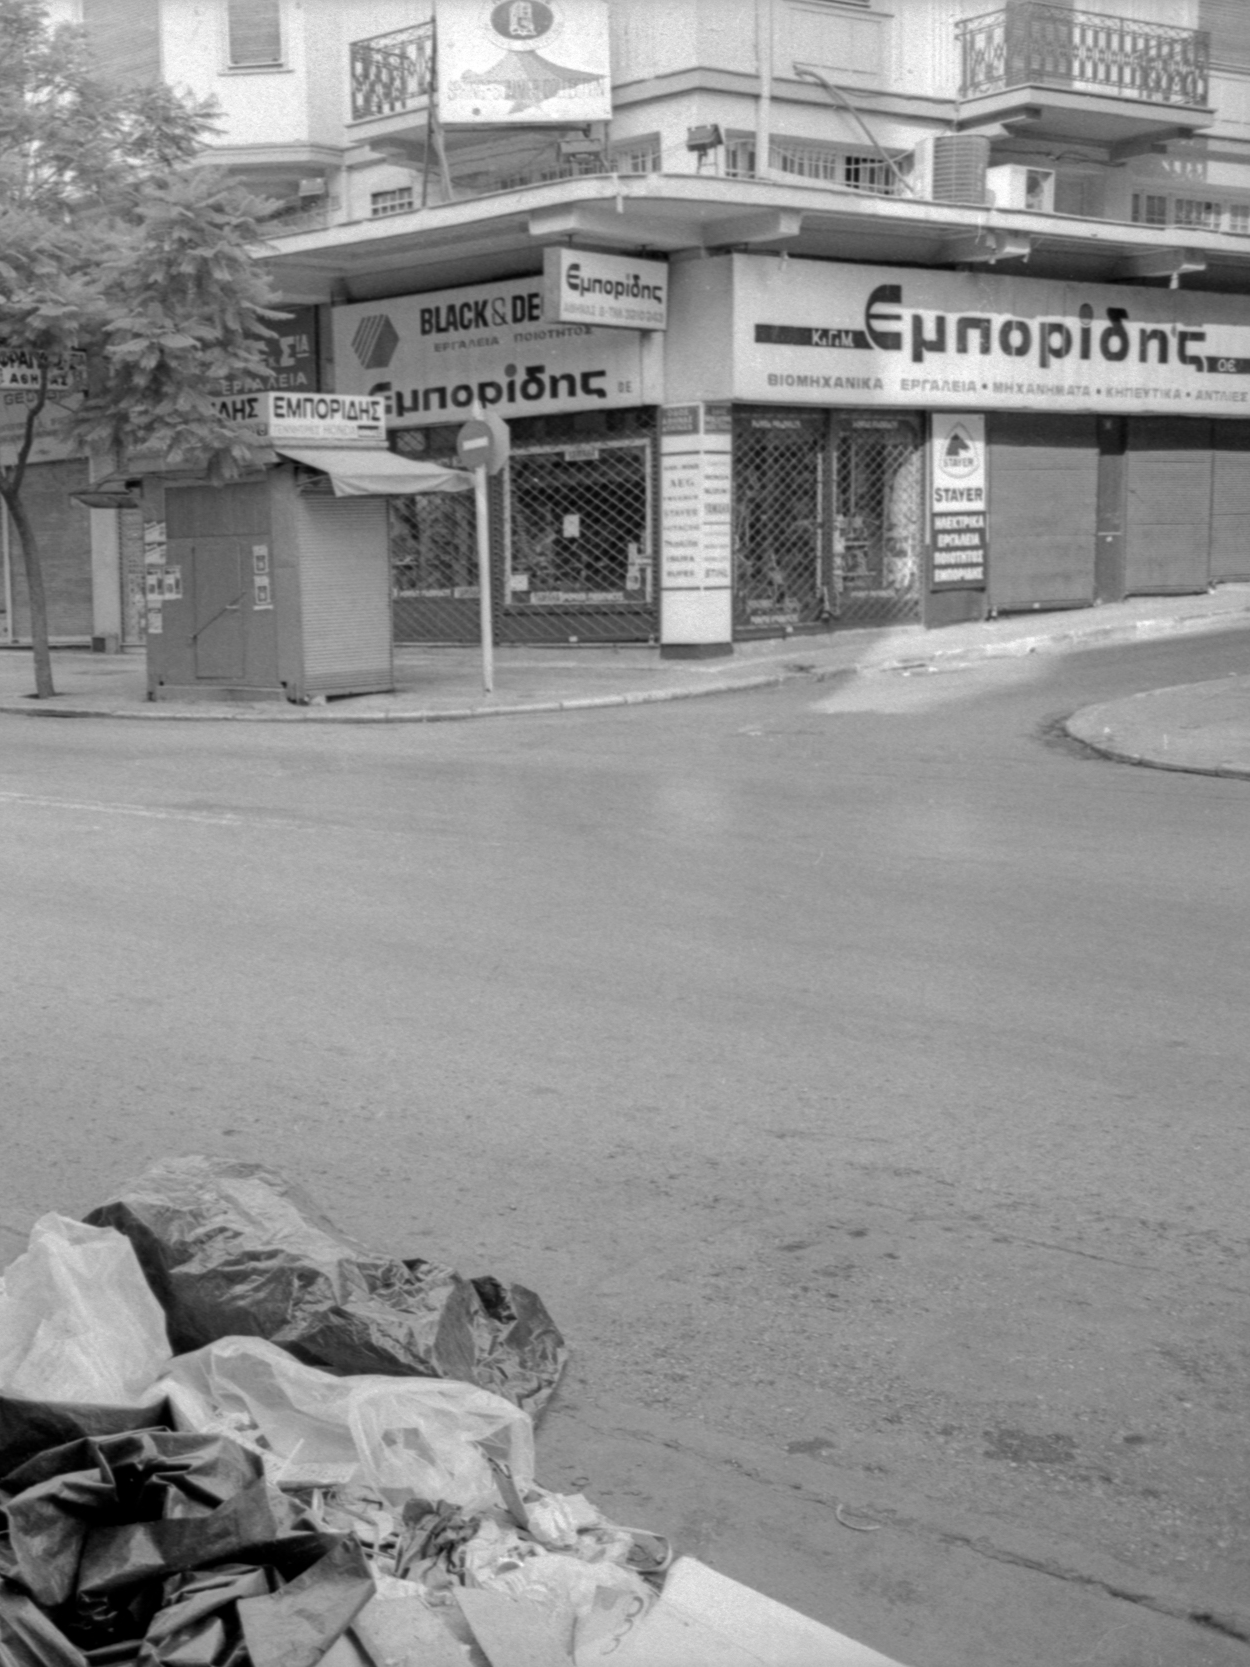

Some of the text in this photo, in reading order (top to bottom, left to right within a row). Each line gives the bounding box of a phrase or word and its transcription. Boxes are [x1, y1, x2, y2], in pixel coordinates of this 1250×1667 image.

[566, 263, 662, 304] Εμπορίδης
[865, 284, 1206, 373] Εμπορίδης
[434, 325, 592, 352] ΕΡΓΑΛΕΙΑ ΠΟΙΟΤΗΤΟΣ
[9, 373, 68, 387] ΑΘΗΑΣ
[767, 373, 884, 390] ΒΙΟΜΗΧΑΝΙΚΑ
[900, 378, 978, 393] ΕΡΓΑΛΕΙΑ
[993, 382, 1091, 397] ΜΗΧΑΝΗΜΑΤΑ
[1106, 386, 1181, 400] ΚΗΠΕΥΤΙΚΑ
[274, 396, 381, 421] ΕΜΠΟΡΙΔΗΣ
[943, 458, 974, 468] STAYER
[934, 487, 983, 502] STAYER
[934, 514, 985, 530] ΗΛΕΚΤΡΙΚΑ
[937, 532, 980, 548] ΕΡΓΑΛΕΙΑ
[934, 550, 984, 565] ΠΟΙΟΤΗΤΟΣ
[934, 566, 984, 582] ΕΜΠΟΡΙΔΗΣ
